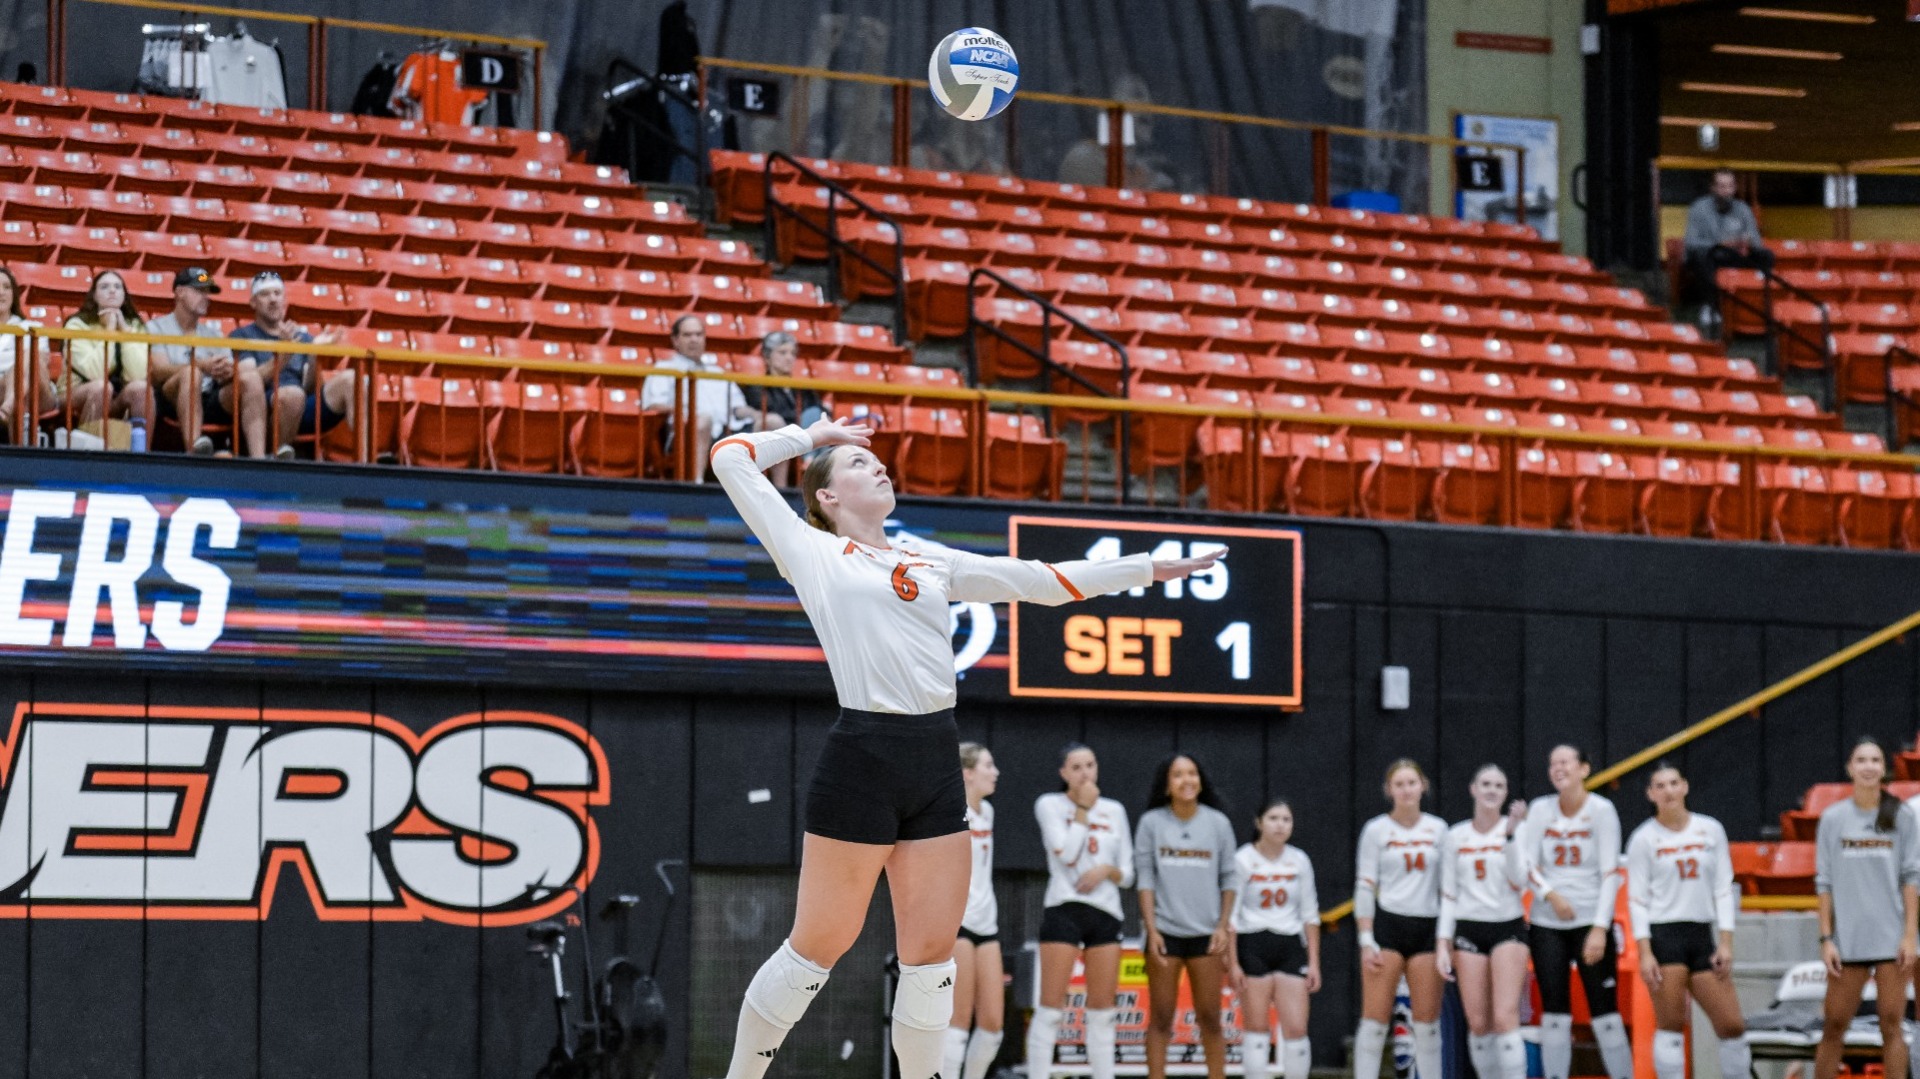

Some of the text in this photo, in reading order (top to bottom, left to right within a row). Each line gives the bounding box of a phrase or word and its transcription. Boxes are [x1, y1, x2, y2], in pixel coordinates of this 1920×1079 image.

[964, 37, 1011, 54] molten
[969, 49, 1010, 69] NCAA
[481, 57, 504, 84] D
[744, 83, 764, 109] E
[1471, 161, 1491, 186] E
[0, 489, 241, 651] ERS
[891, 562, 919, 602] 6
[1064, 614, 1251, 680] SET 1
[1404, 852, 1426, 872] 14
[1554, 845, 1581, 866] 23
[1474, 859, 1486, 880] 5
[1676, 858, 1699, 879] 12
[1260, 888, 1287, 909] 20
